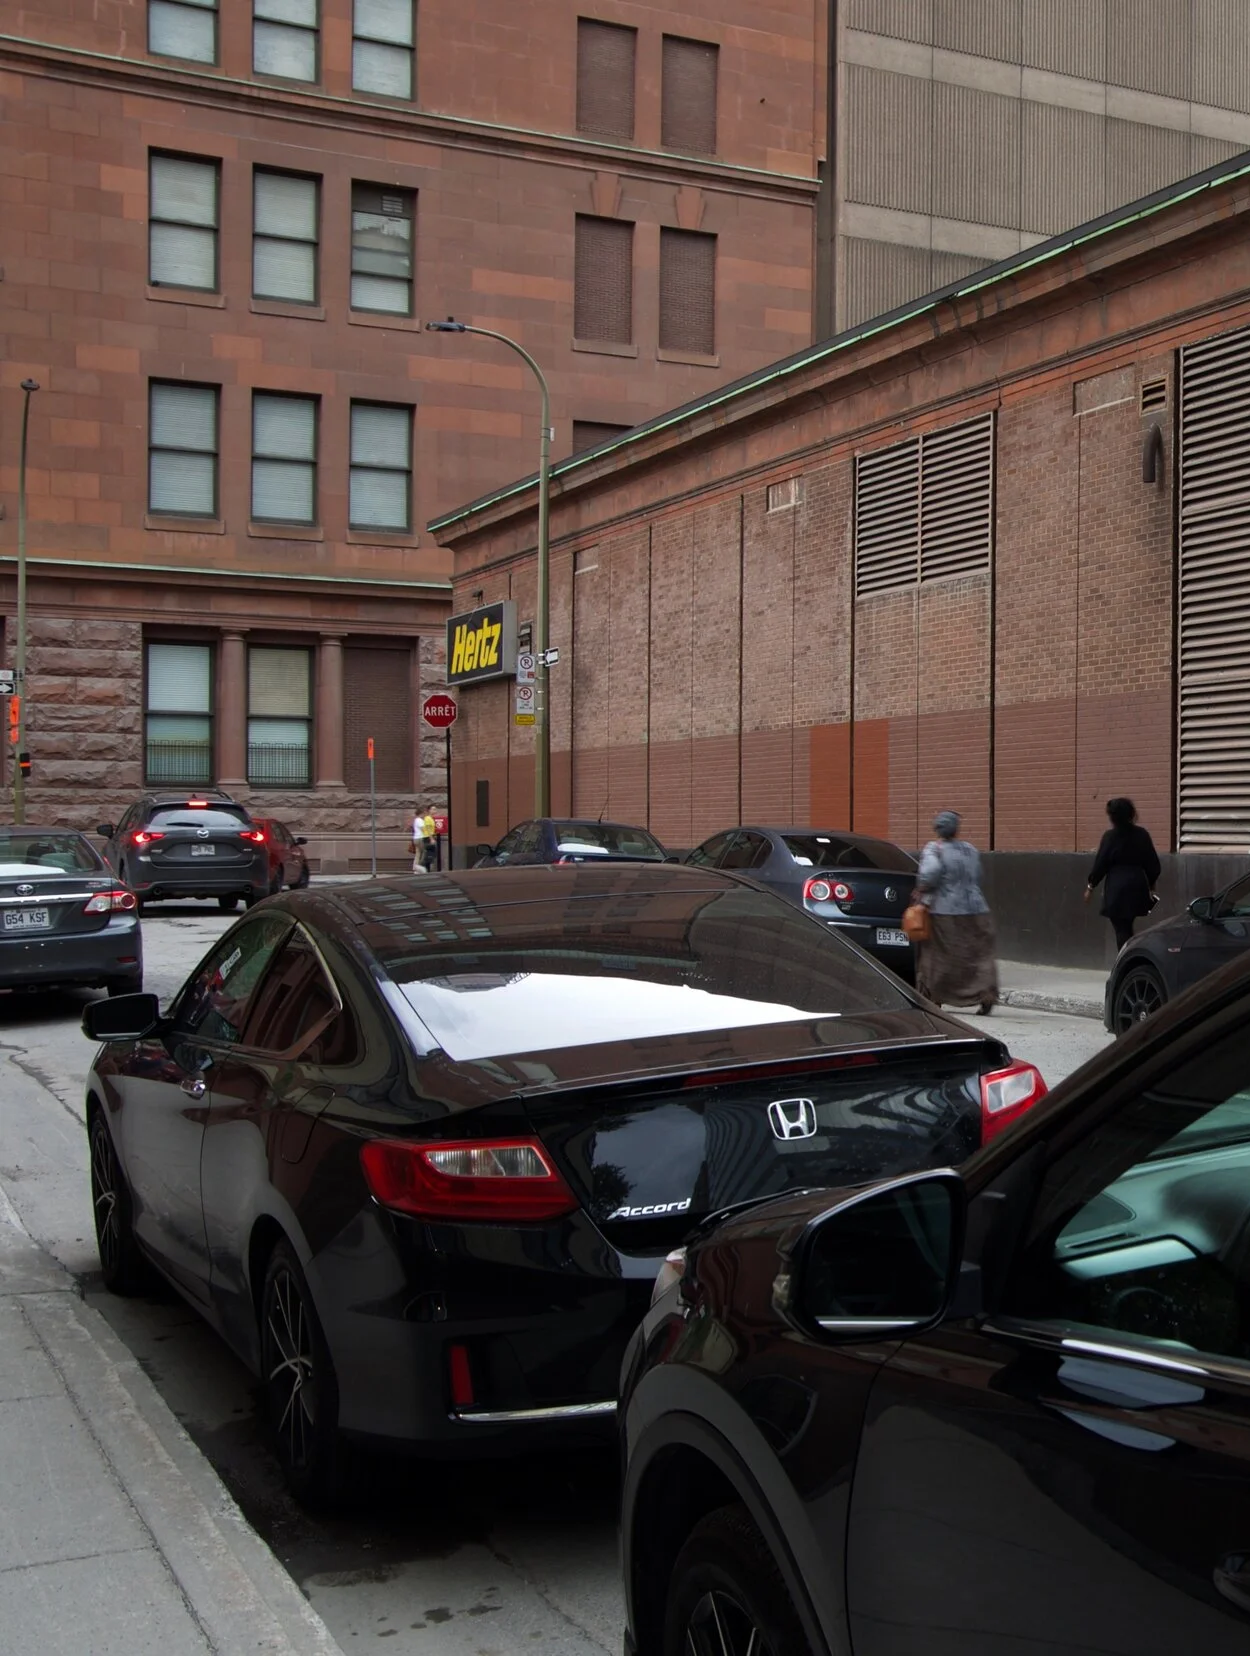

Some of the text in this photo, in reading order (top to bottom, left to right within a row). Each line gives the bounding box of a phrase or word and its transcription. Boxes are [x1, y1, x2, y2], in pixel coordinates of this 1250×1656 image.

[451, 617, 501, 675] Hertz
[425, 704, 456, 717] ARRÊT
[5, 911, 47, 925] G54 KSF
[606, 1197, 692, 1221] Accord
